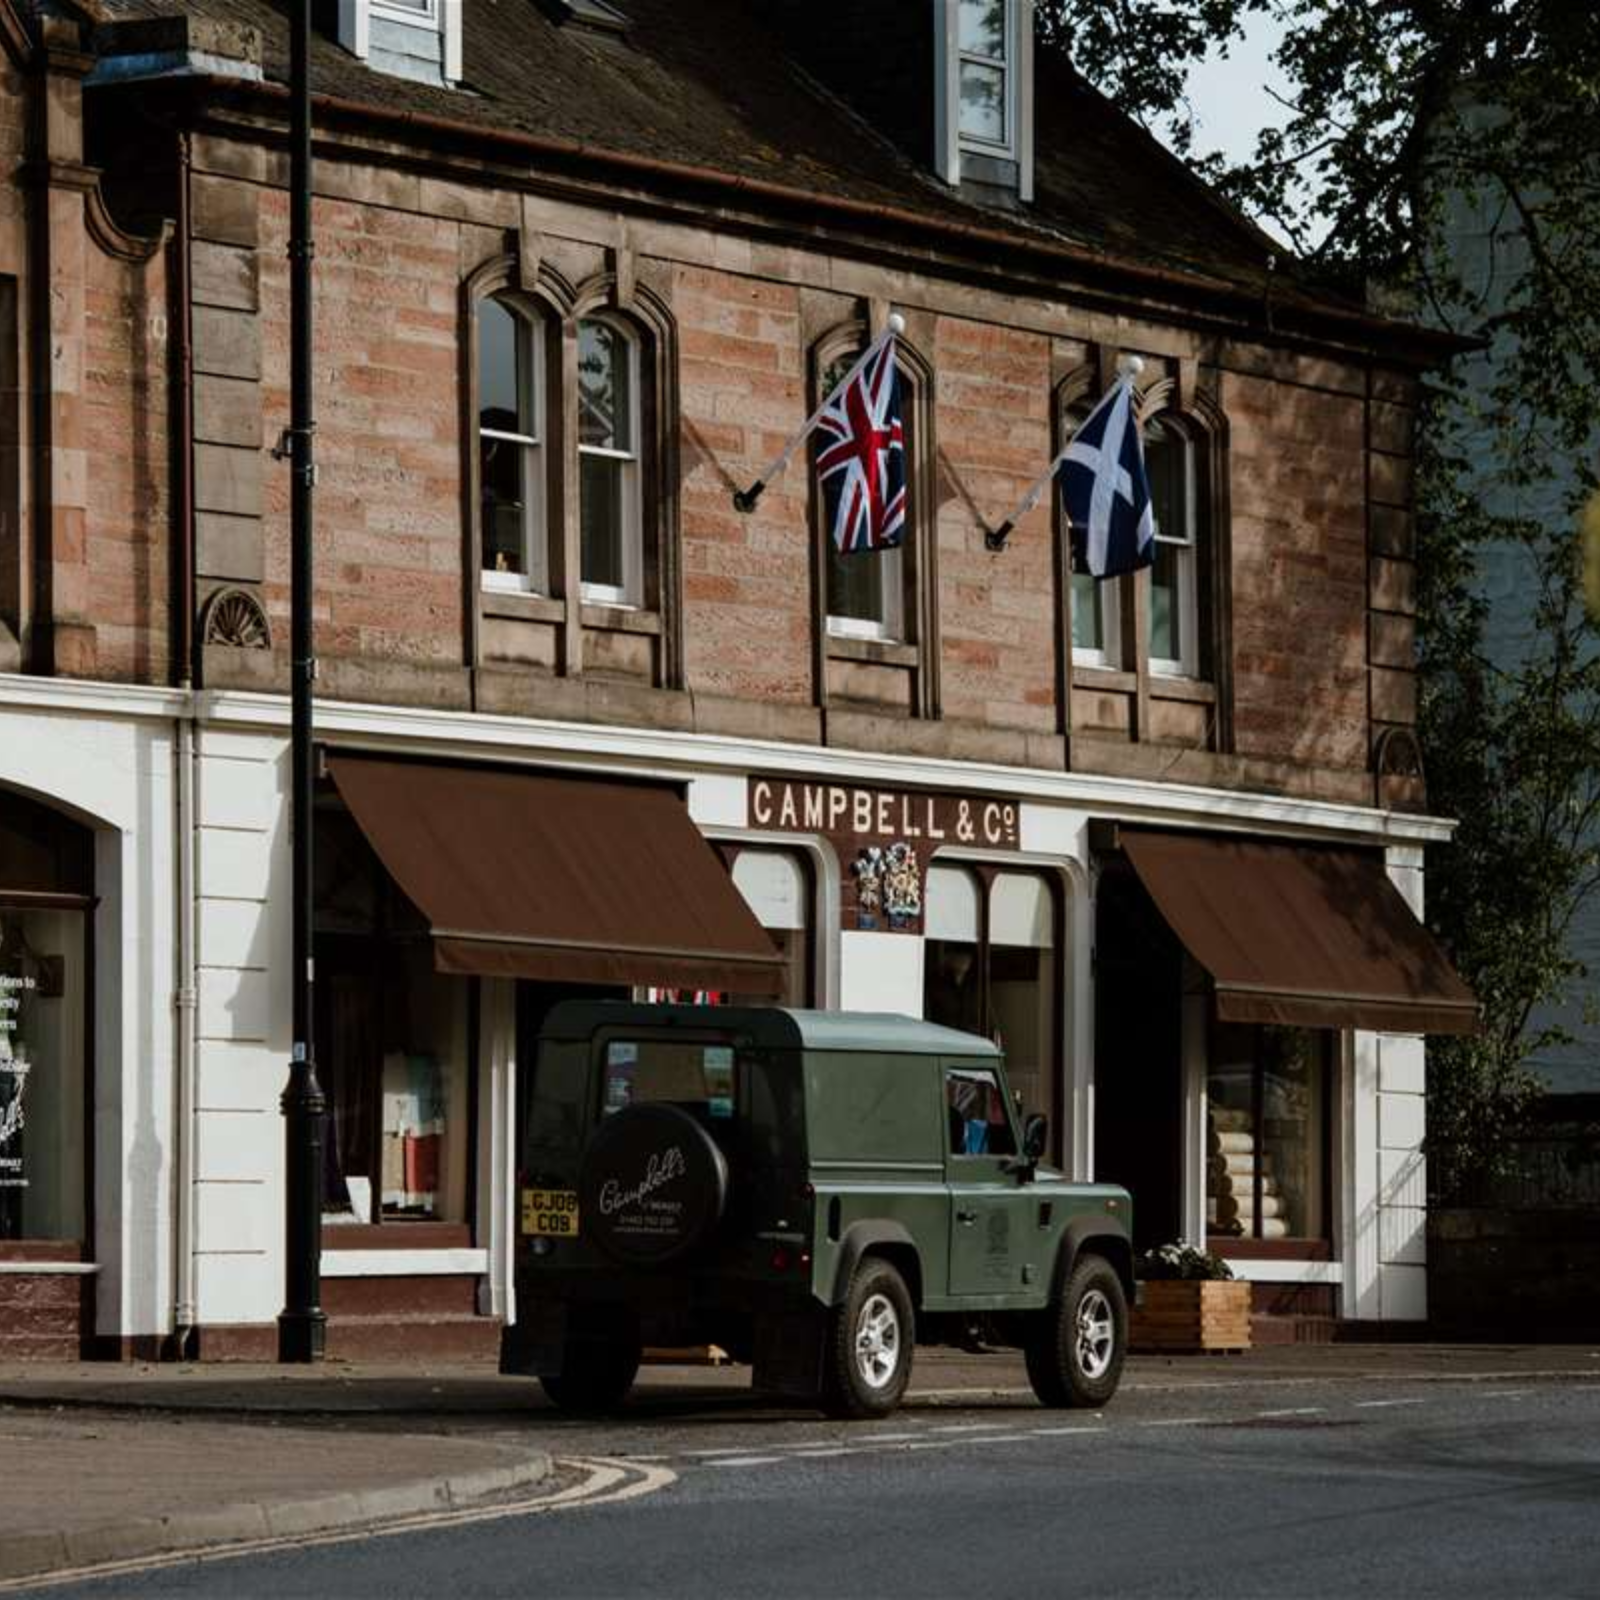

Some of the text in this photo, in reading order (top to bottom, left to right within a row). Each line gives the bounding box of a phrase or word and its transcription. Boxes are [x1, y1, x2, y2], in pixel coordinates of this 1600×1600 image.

[754, 781, 945, 838] CAMPBELL
[956, 800, 975, 841] &
[599, 1146, 686, 1215] Campbell's
